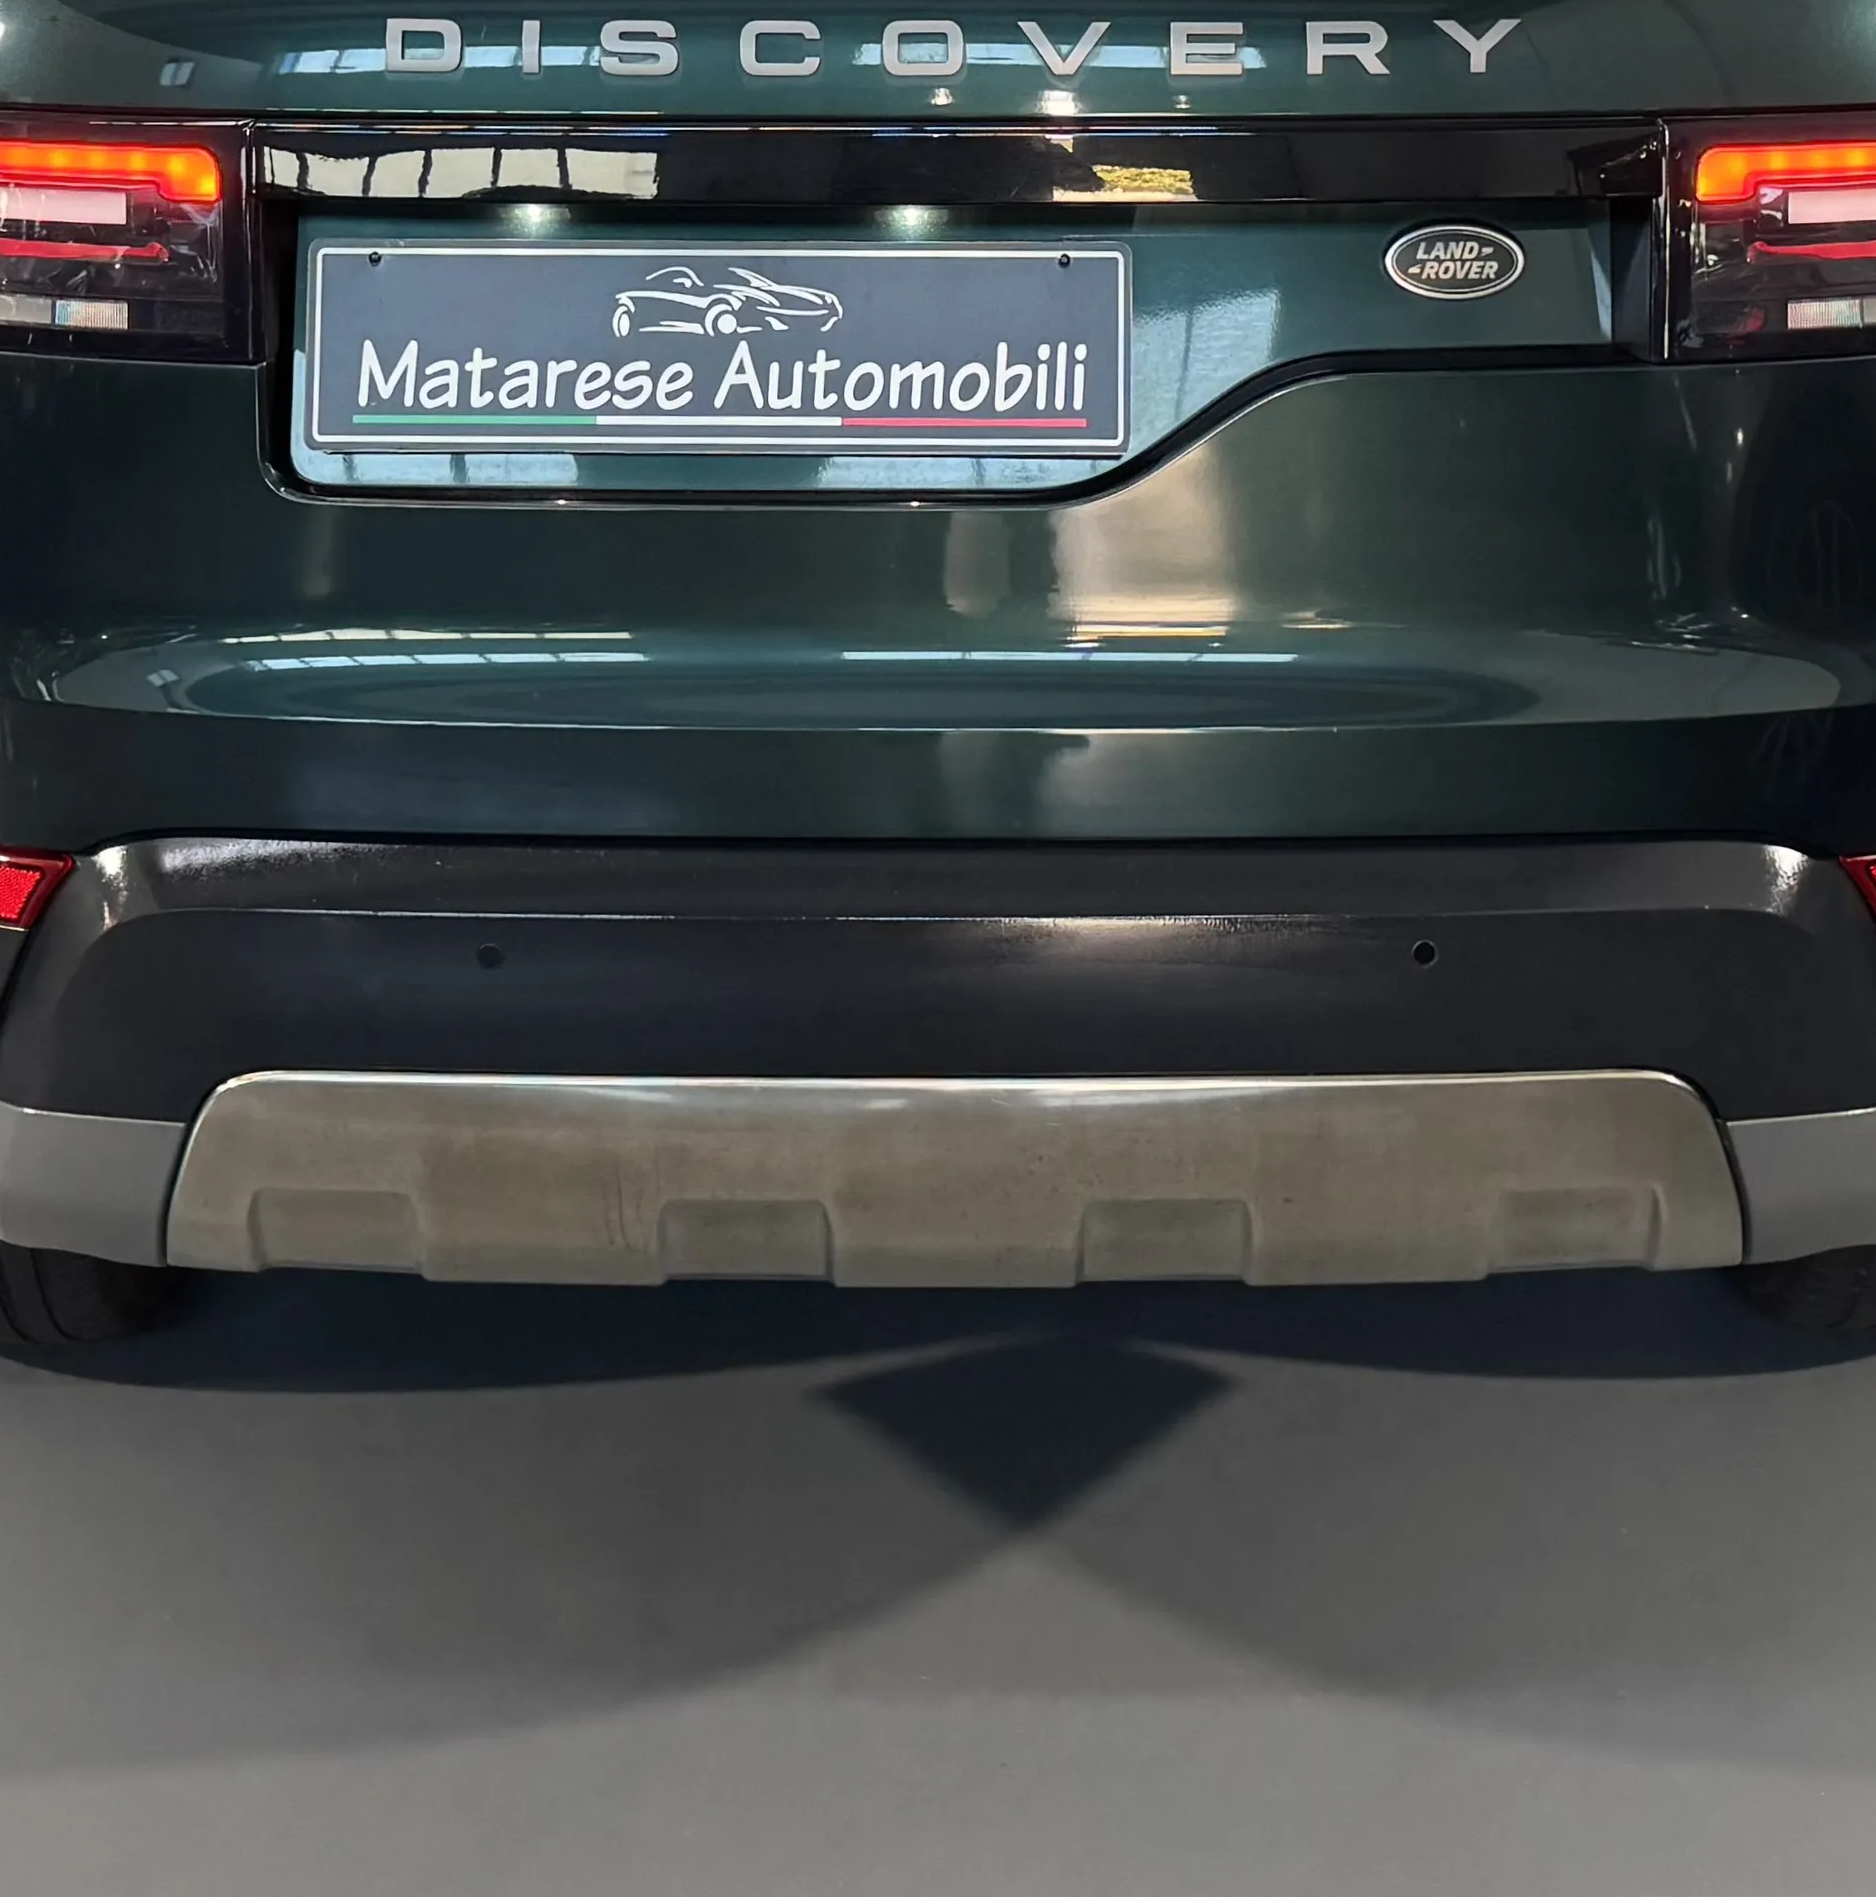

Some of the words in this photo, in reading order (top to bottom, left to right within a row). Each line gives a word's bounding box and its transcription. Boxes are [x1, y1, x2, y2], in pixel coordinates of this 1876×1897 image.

[385, 19, 1520, 76] DISCOVERY
[1415, 241, 1480, 260] LAND
[1421, 260, 1499, 279] ROVER
[357, 338, 694, 411] Matarese
[713, 339, 1088, 412] Automobili
